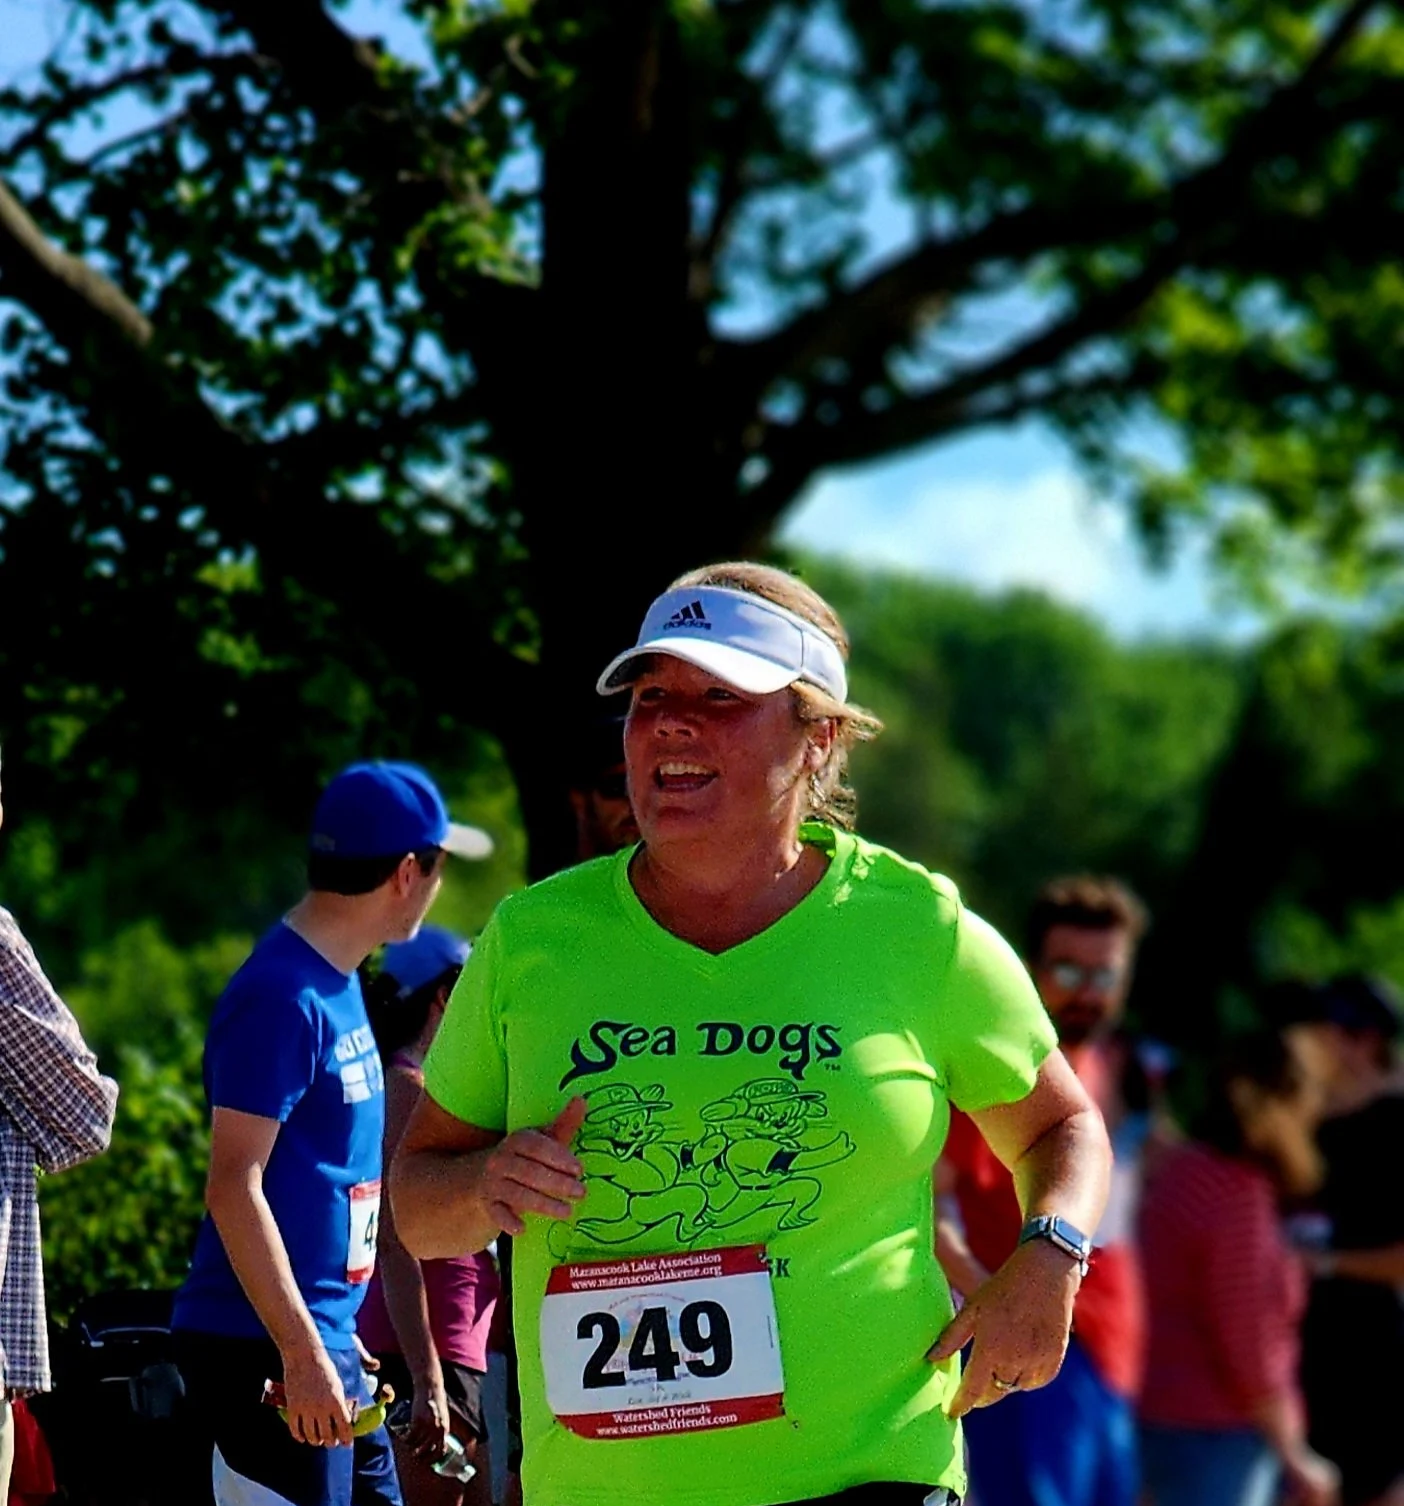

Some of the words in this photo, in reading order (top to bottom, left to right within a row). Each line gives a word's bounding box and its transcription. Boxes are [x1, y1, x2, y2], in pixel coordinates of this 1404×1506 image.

[559, 1021, 676, 1091] Sea
[696, 1021, 843, 1080] Dogs
[569, 1262, 630, 1278] Maranacook
[631, 1259, 657, 1273] Lake
[658, 1253, 721, 1270] Association
[577, 1300, 732, 1389] 249
[596, 1413, 738, 1435] www.watershedfriends.com
[612, 1407, 668, 1423] Watershed
[669, 1403, 711, 1418] Friends
